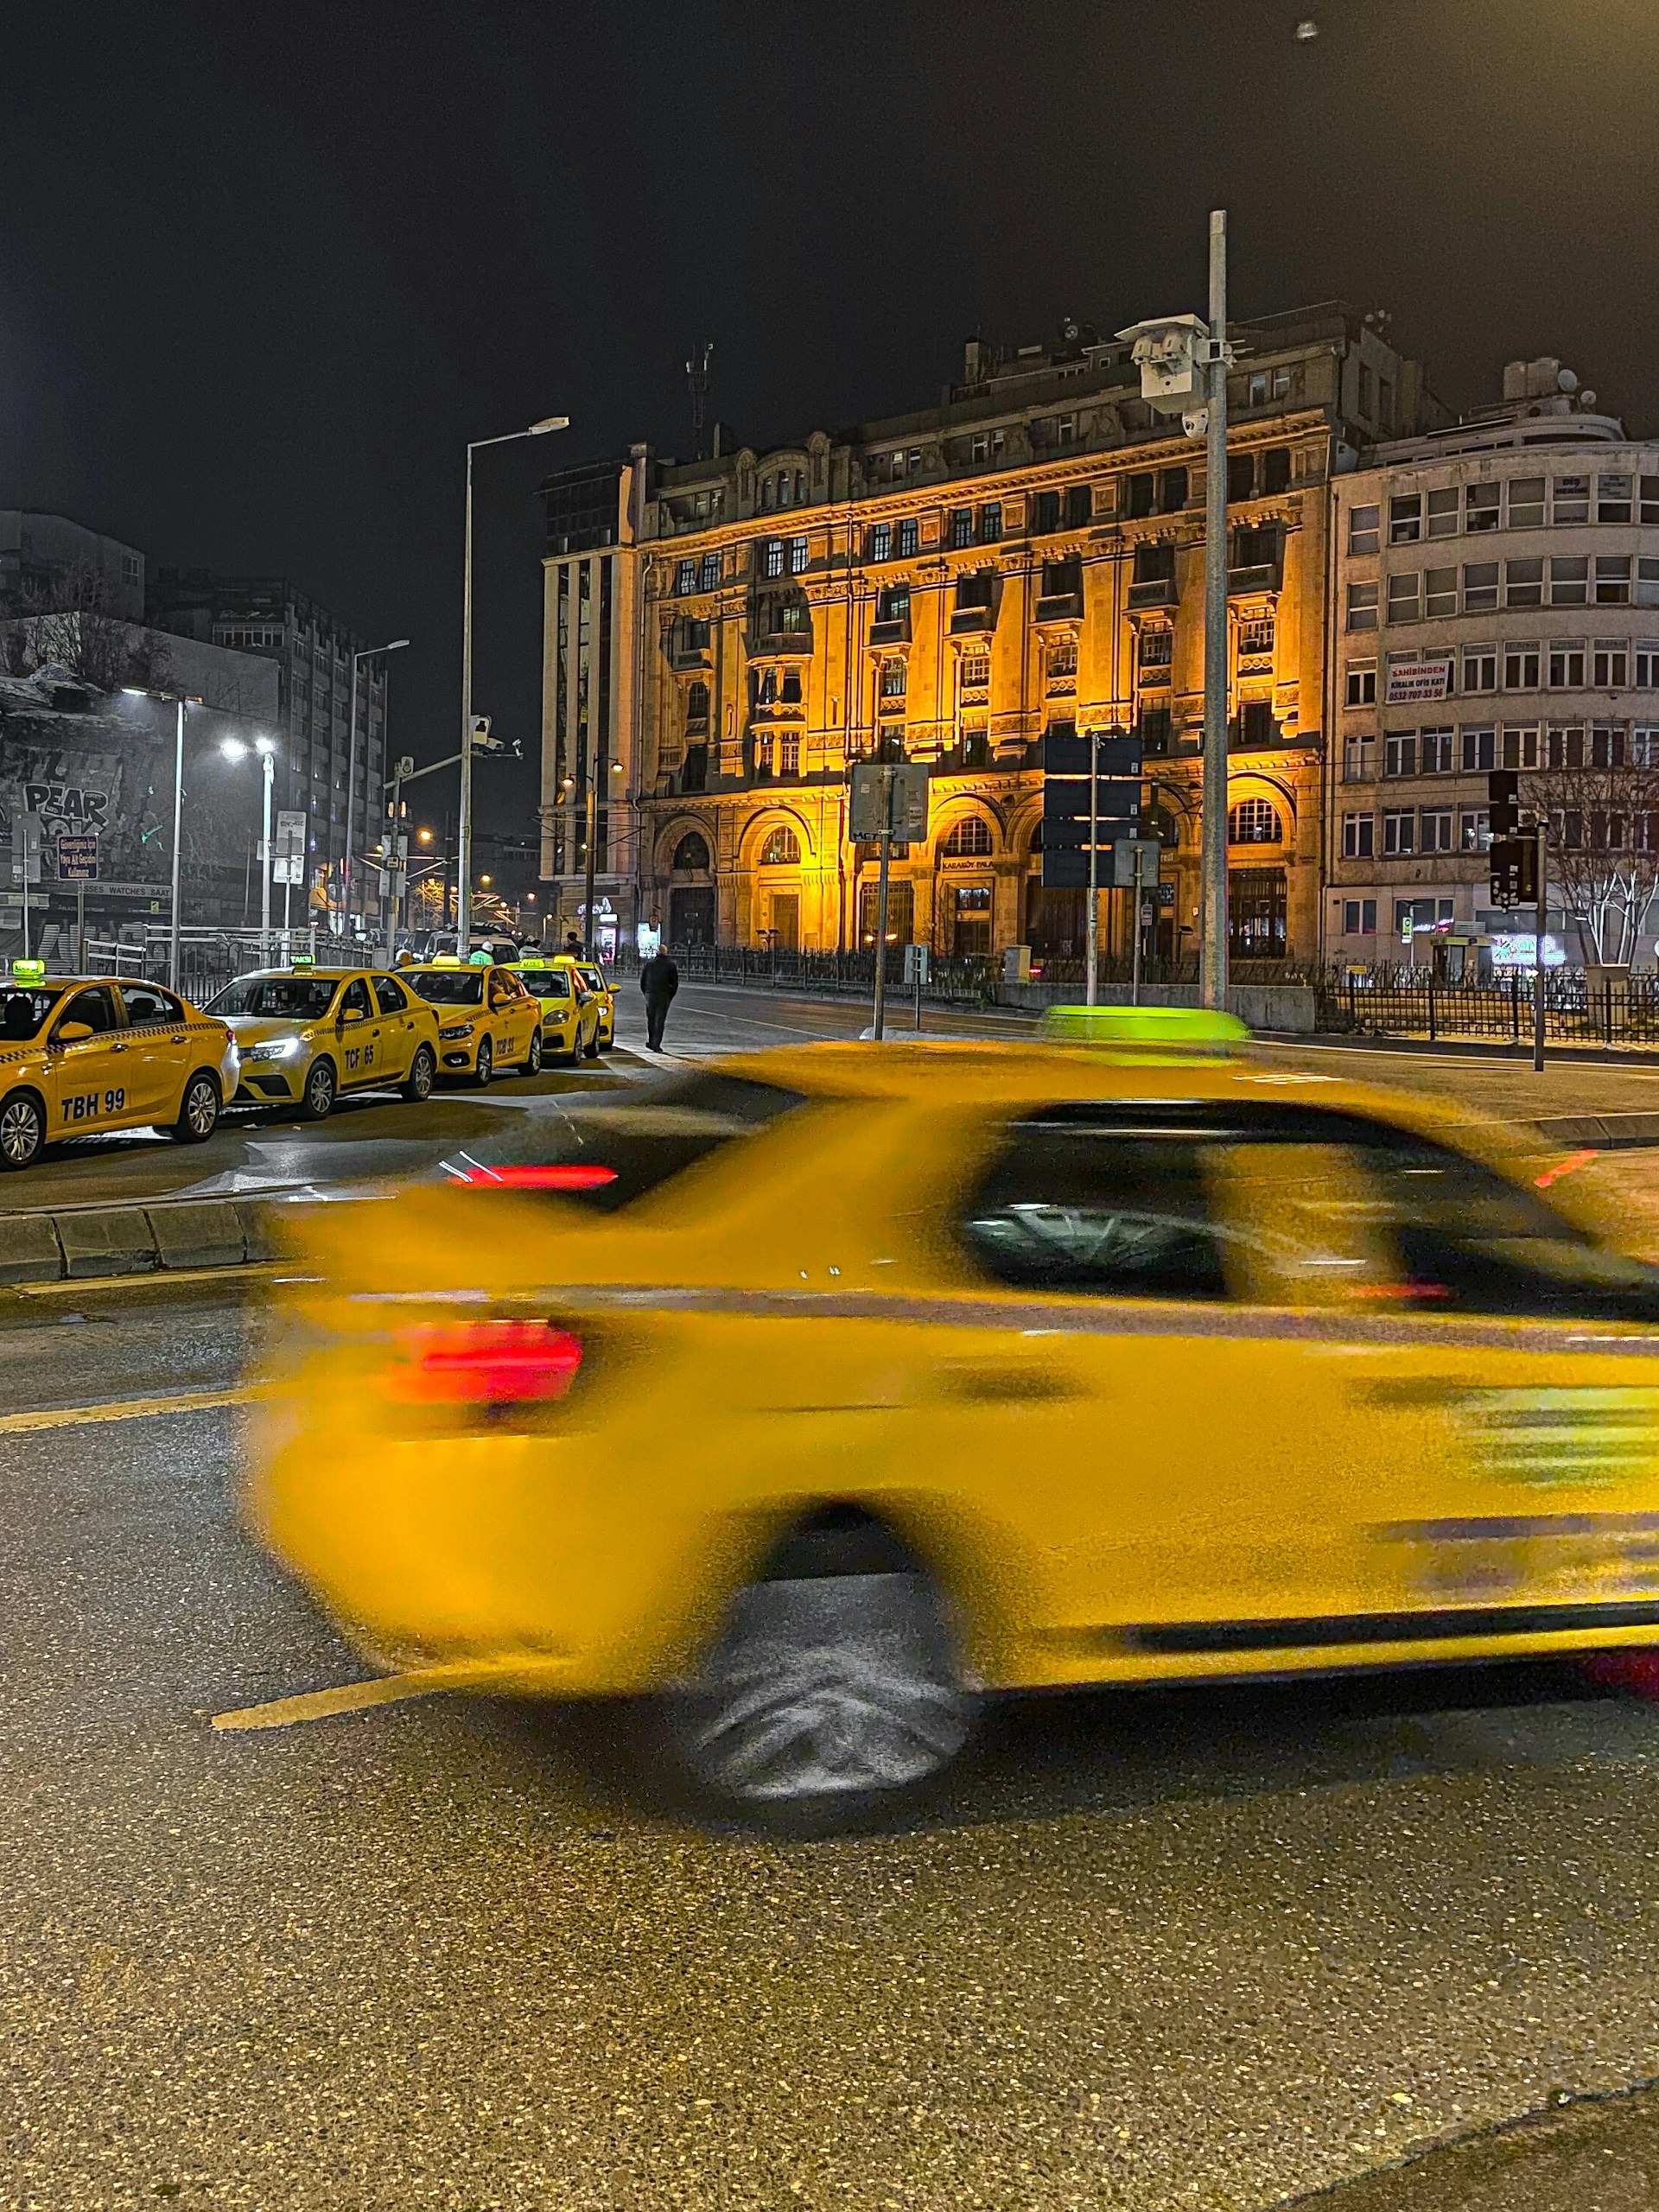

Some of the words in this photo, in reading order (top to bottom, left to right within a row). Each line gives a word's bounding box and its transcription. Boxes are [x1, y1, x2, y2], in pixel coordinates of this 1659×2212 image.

[1392, 666, 1446, 677] SAHİBİNDEN
[1391, 680, 1414, 689] KİRALIK
[1415, 678, 1430, 687] OFİS
[1431, 677, 1445, 686] KATI
[23, 784, 110, 826] PEAR
[110, 887, 145, 896] WATCHES
[150, 888, 169, 897] SAAT
[345, 1047, 360, 1070] TCF
[365, 1045, 374, 1065] 65
[61, 1092, 99, 1122] TBH
[105, 1087, 125, 1113] 99
